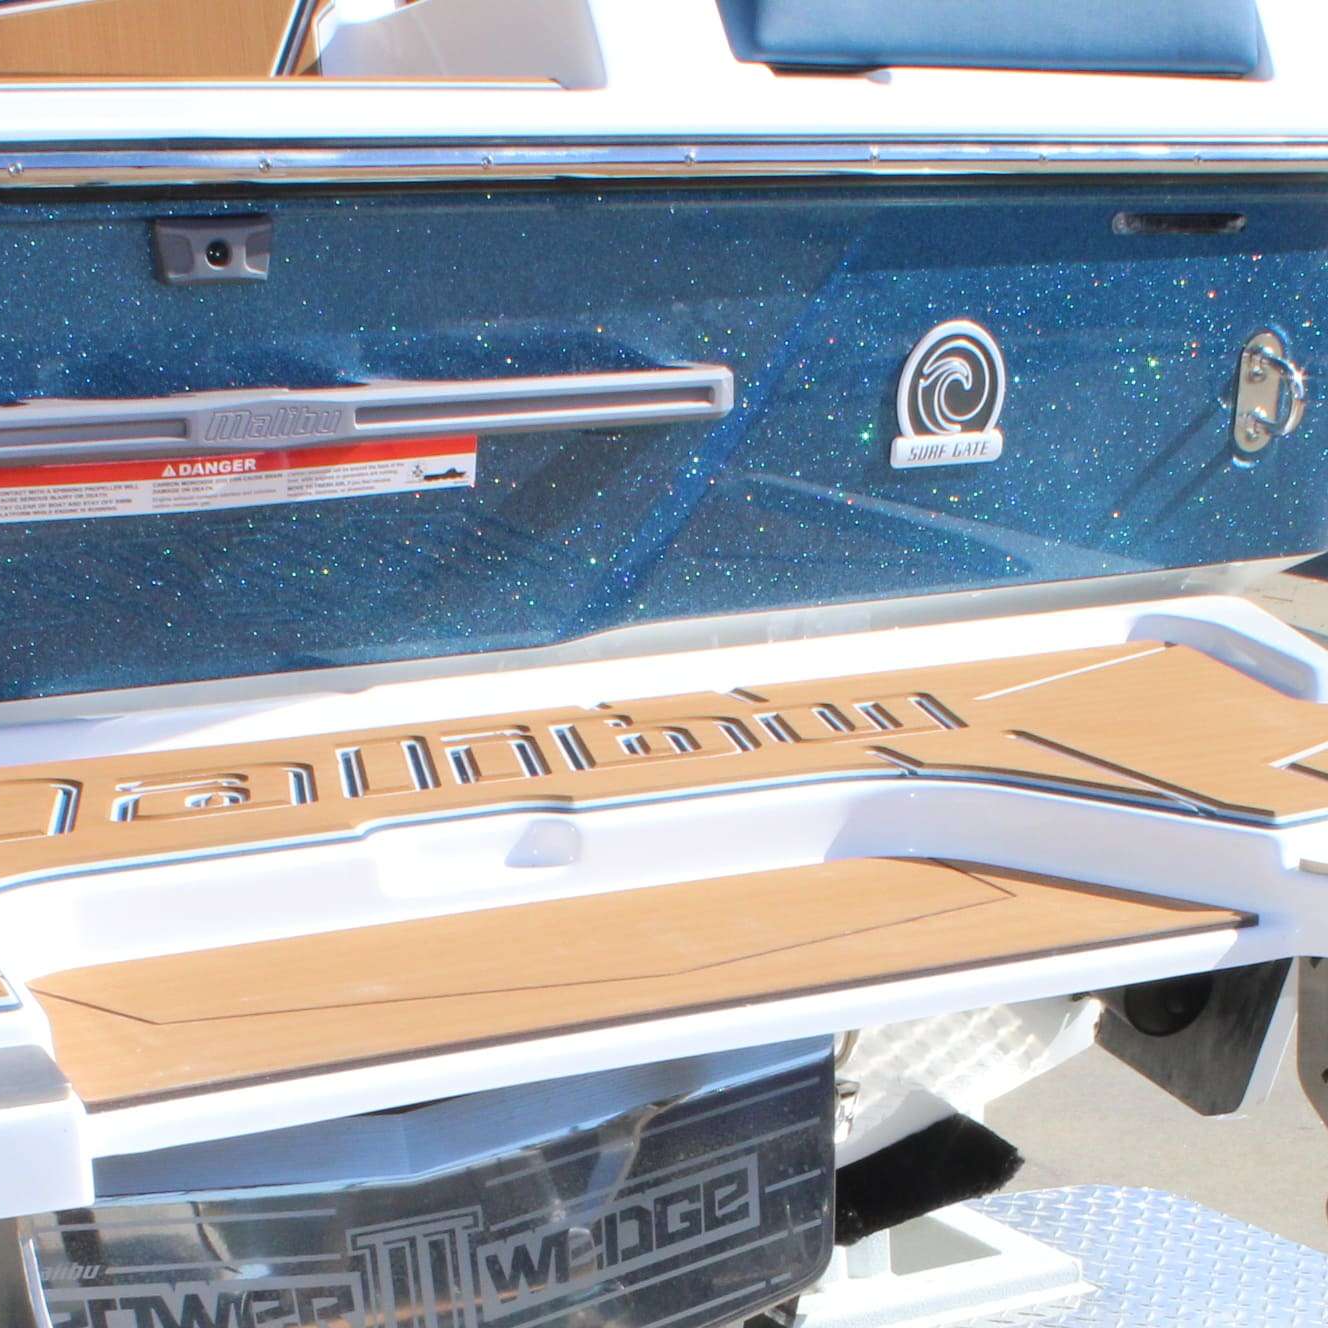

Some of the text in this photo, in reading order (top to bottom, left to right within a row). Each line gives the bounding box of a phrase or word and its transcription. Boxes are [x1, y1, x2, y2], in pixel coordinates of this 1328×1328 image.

[907, 440, 990, 461] SURF GATE
[179, 458, 256, 476] DANGER
